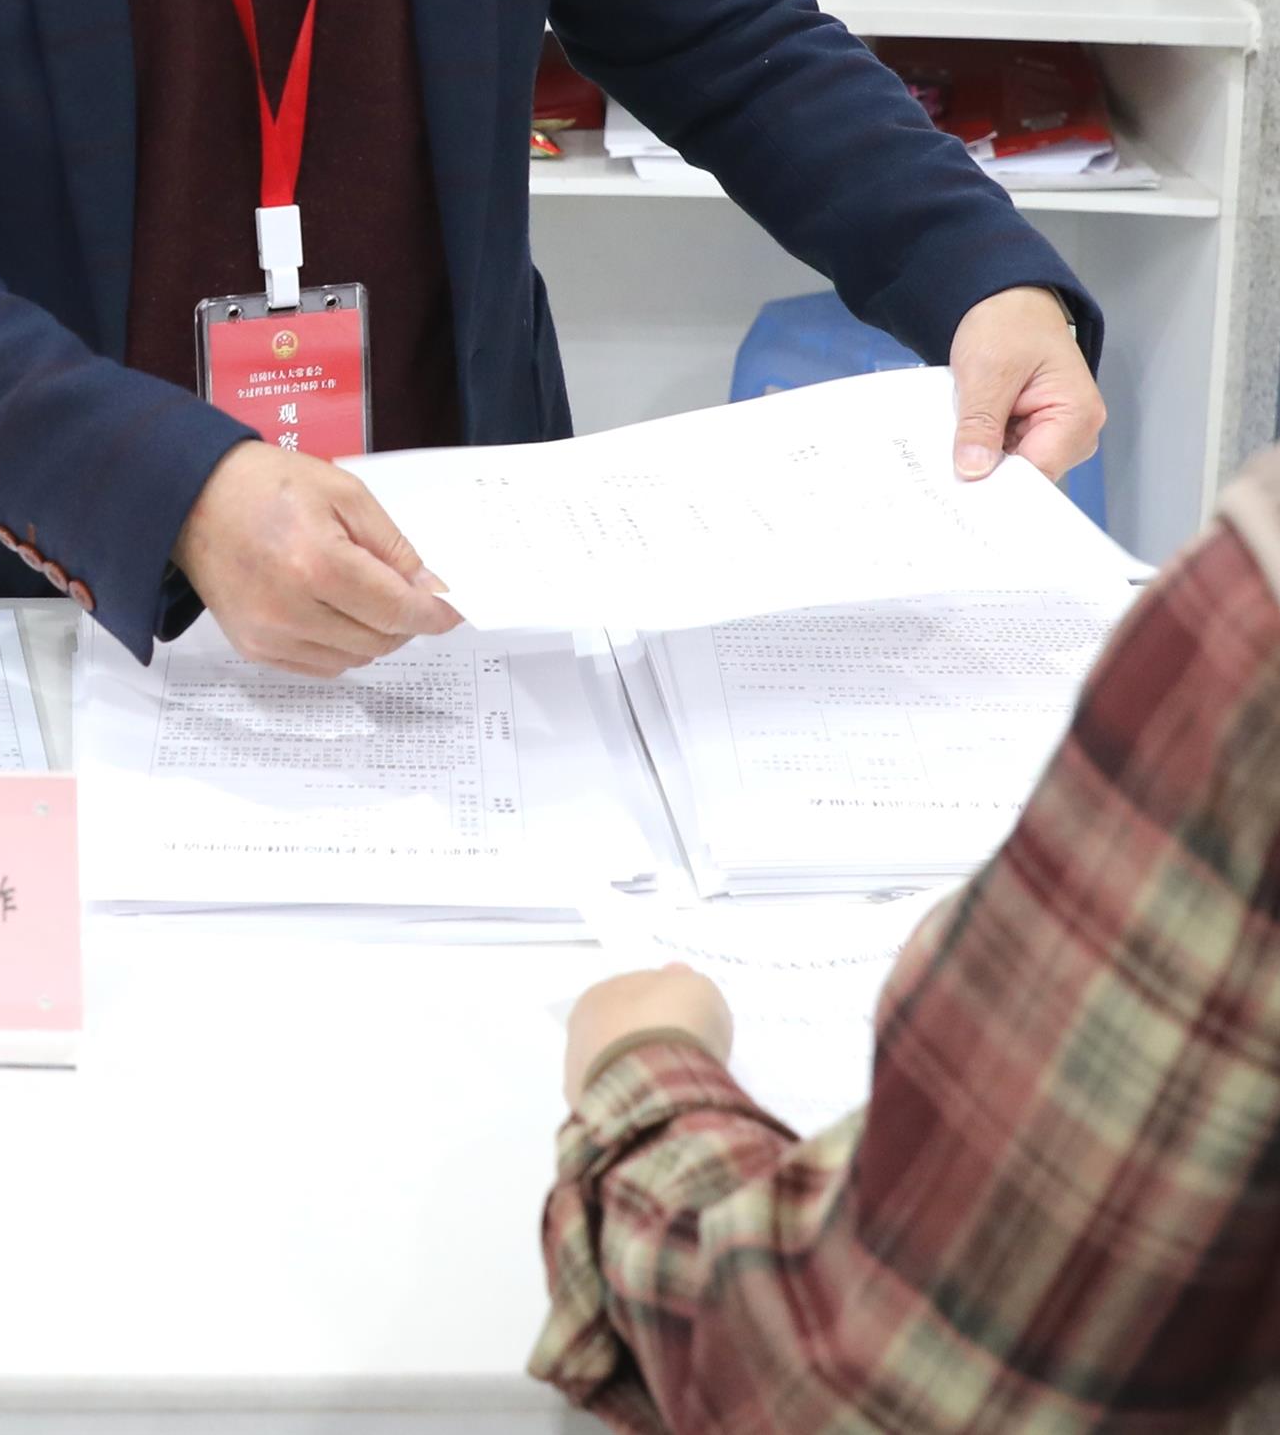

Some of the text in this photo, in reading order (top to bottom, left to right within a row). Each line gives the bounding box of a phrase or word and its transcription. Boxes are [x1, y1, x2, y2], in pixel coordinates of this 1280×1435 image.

[249, 365, 323, 383] 涪陵区人大常委会
[237, 378, 336, 399] 全过程监督社会保障工作
